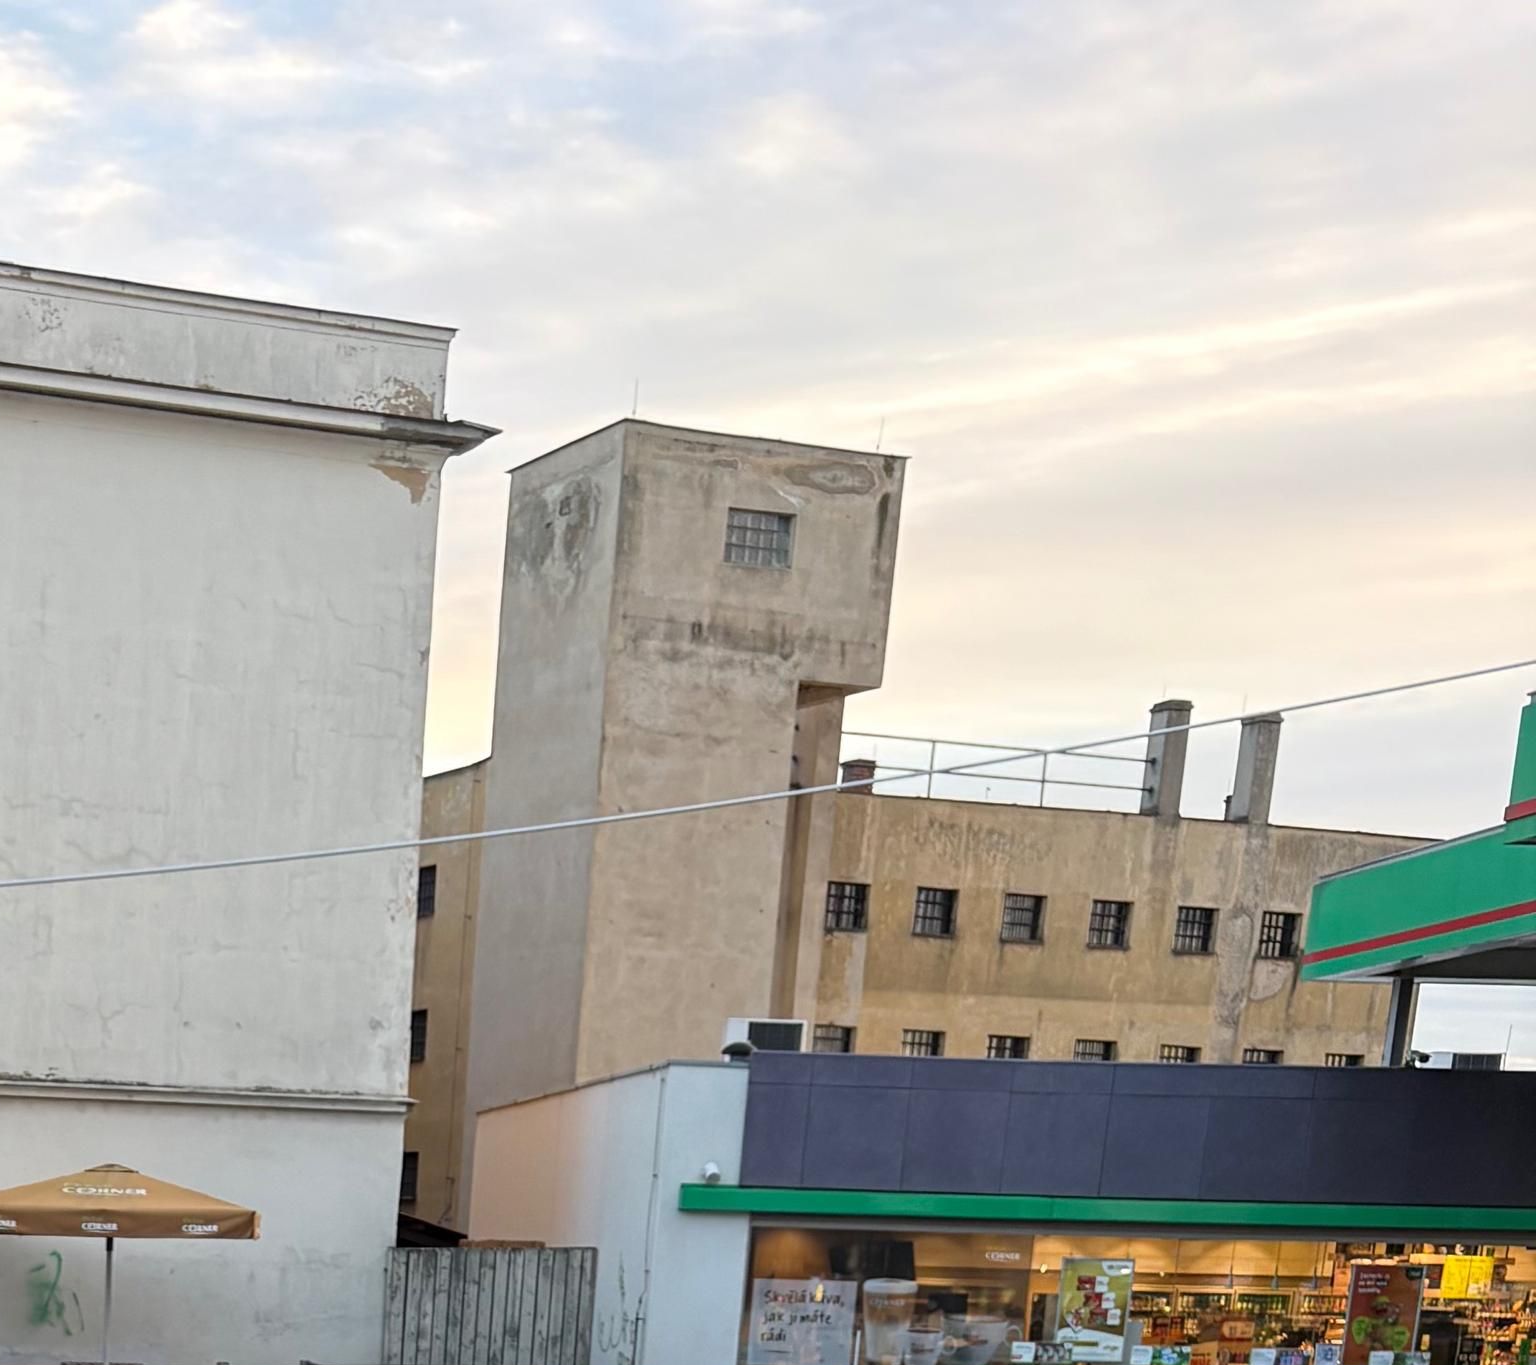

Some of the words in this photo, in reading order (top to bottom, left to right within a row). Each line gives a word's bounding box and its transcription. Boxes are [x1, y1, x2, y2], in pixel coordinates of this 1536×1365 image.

[62, 1187, 147, 1196] CORNER
[762, 1310, 784, 1324] jak
[761, 1328, 786, 1341] rádi
